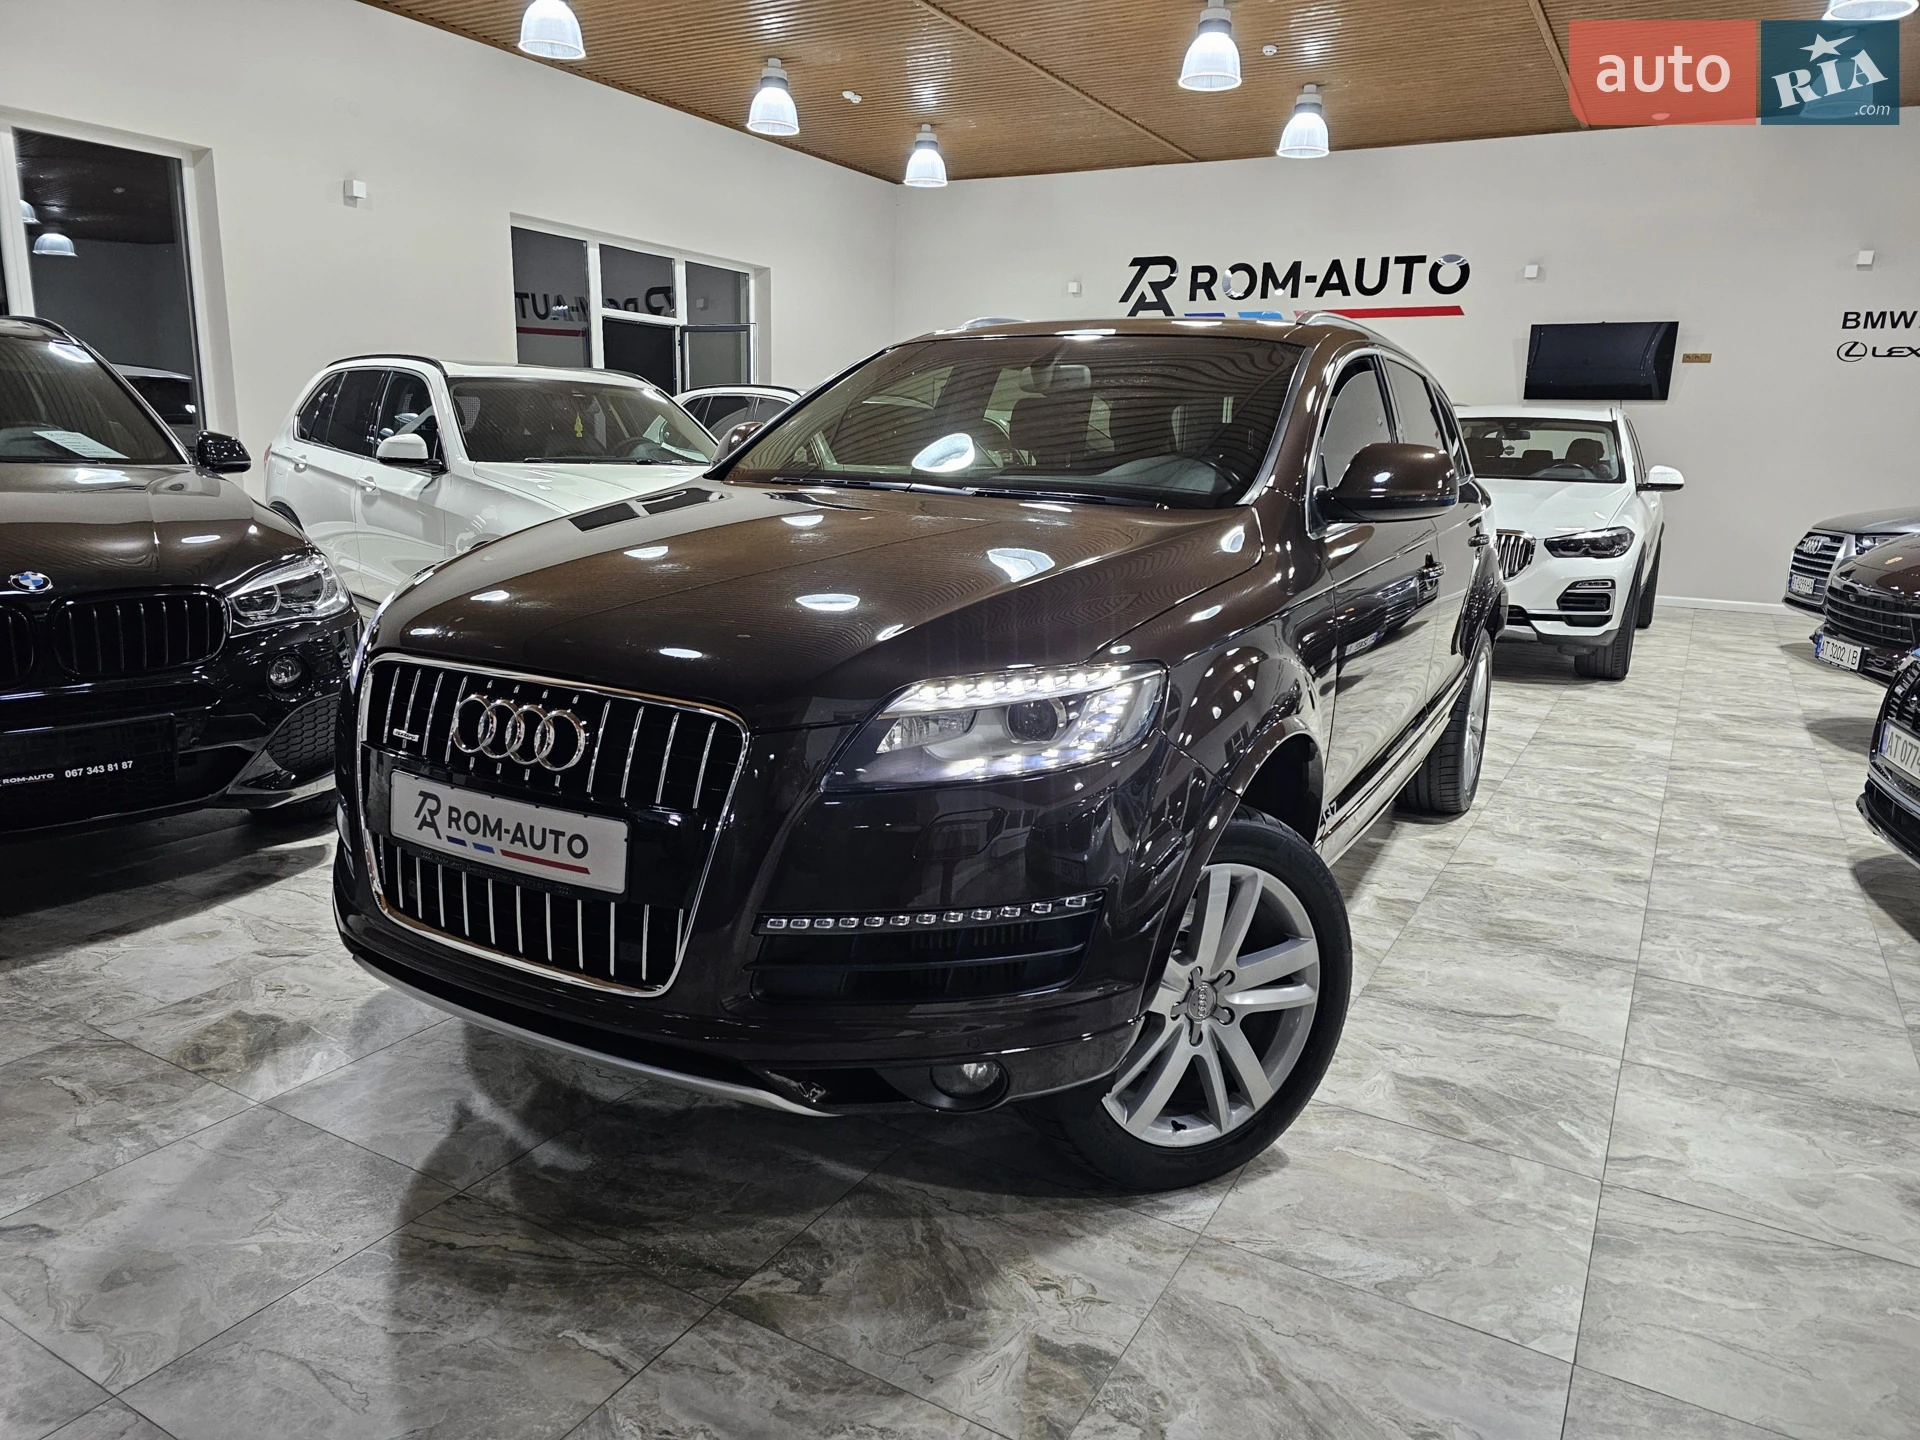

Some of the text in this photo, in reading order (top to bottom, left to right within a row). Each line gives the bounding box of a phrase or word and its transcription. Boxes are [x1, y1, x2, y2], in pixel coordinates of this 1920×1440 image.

[1188, 253, 1471, 302] ROM-AUTO
[1841, 310, 1919, 330] BMW
[1885, 731, 1902, 759] AT
[2, 760, 134, 785] ROM-AUTO 067 343 81 87
[447, 806, 589, 859] ROM-AUTO
